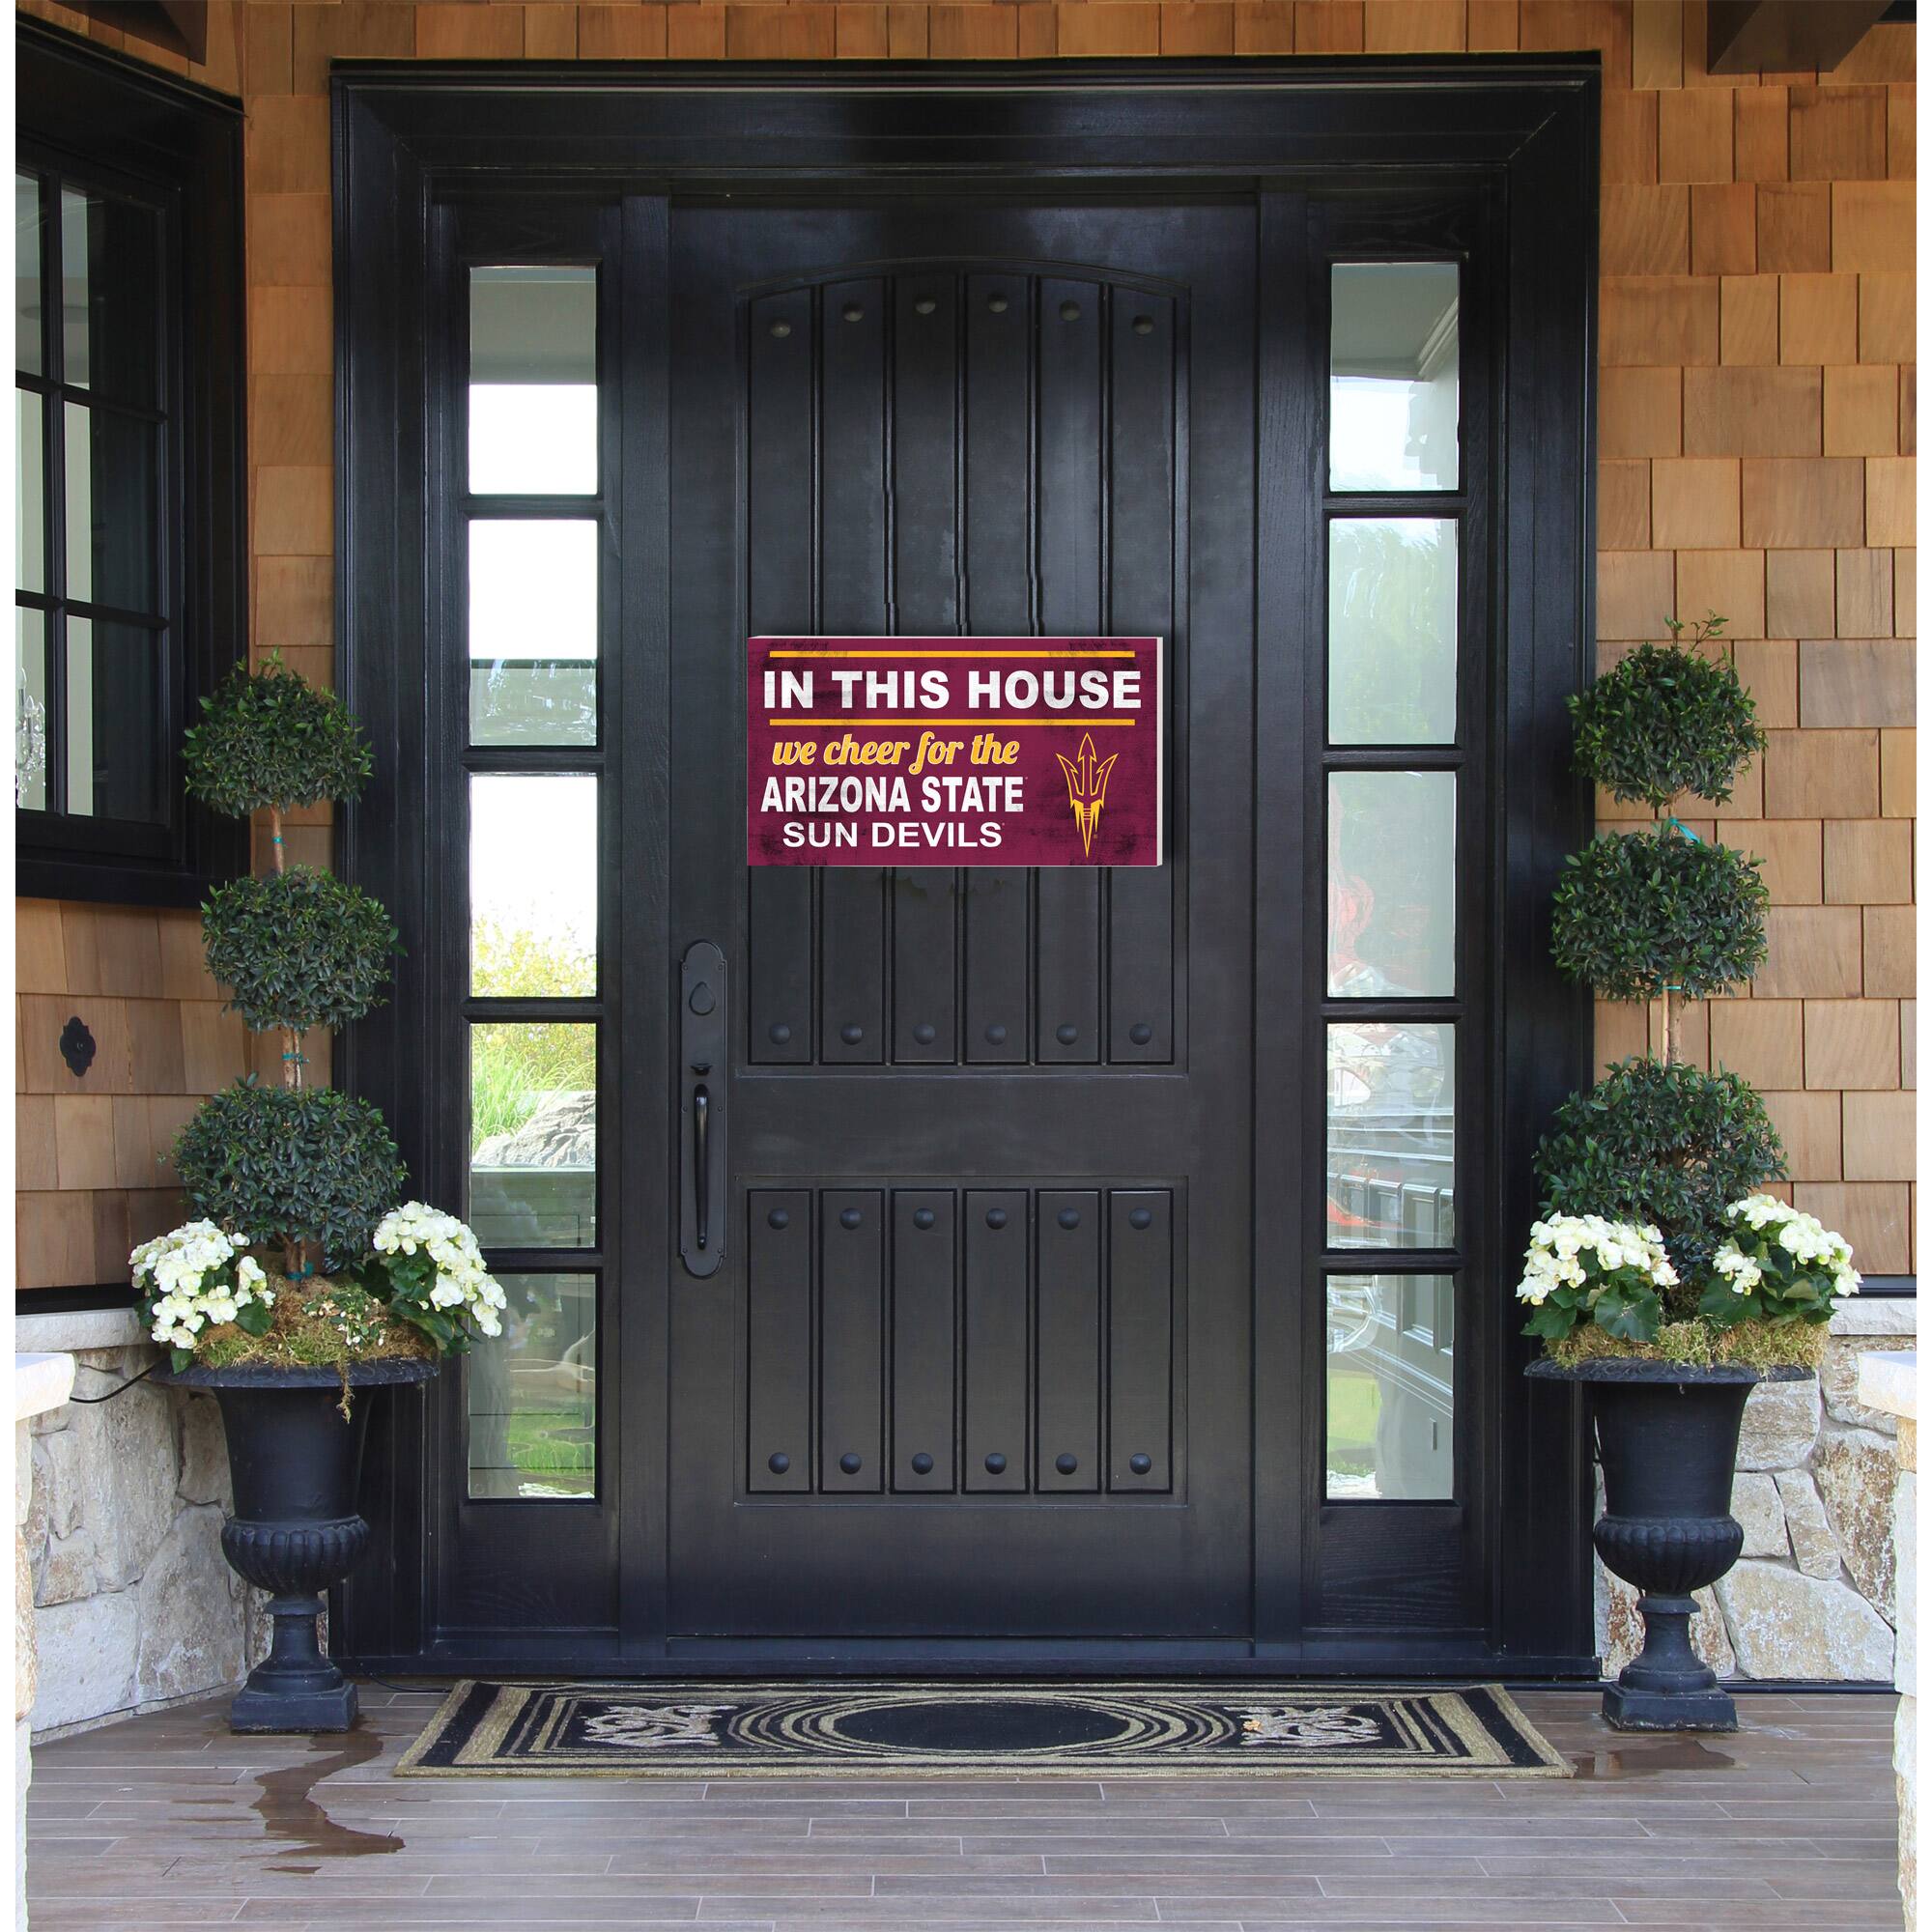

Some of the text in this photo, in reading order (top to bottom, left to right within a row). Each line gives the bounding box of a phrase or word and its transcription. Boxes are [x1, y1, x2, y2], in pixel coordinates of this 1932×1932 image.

[763, 669, 1142, 709] IN THIS HOUSE
[772, 730, 1020, 776] we cheer for the
[760, 776, 1024, 812] ARIZONA STATE
[782, 821, 1003, 847] SUN DEVILS
